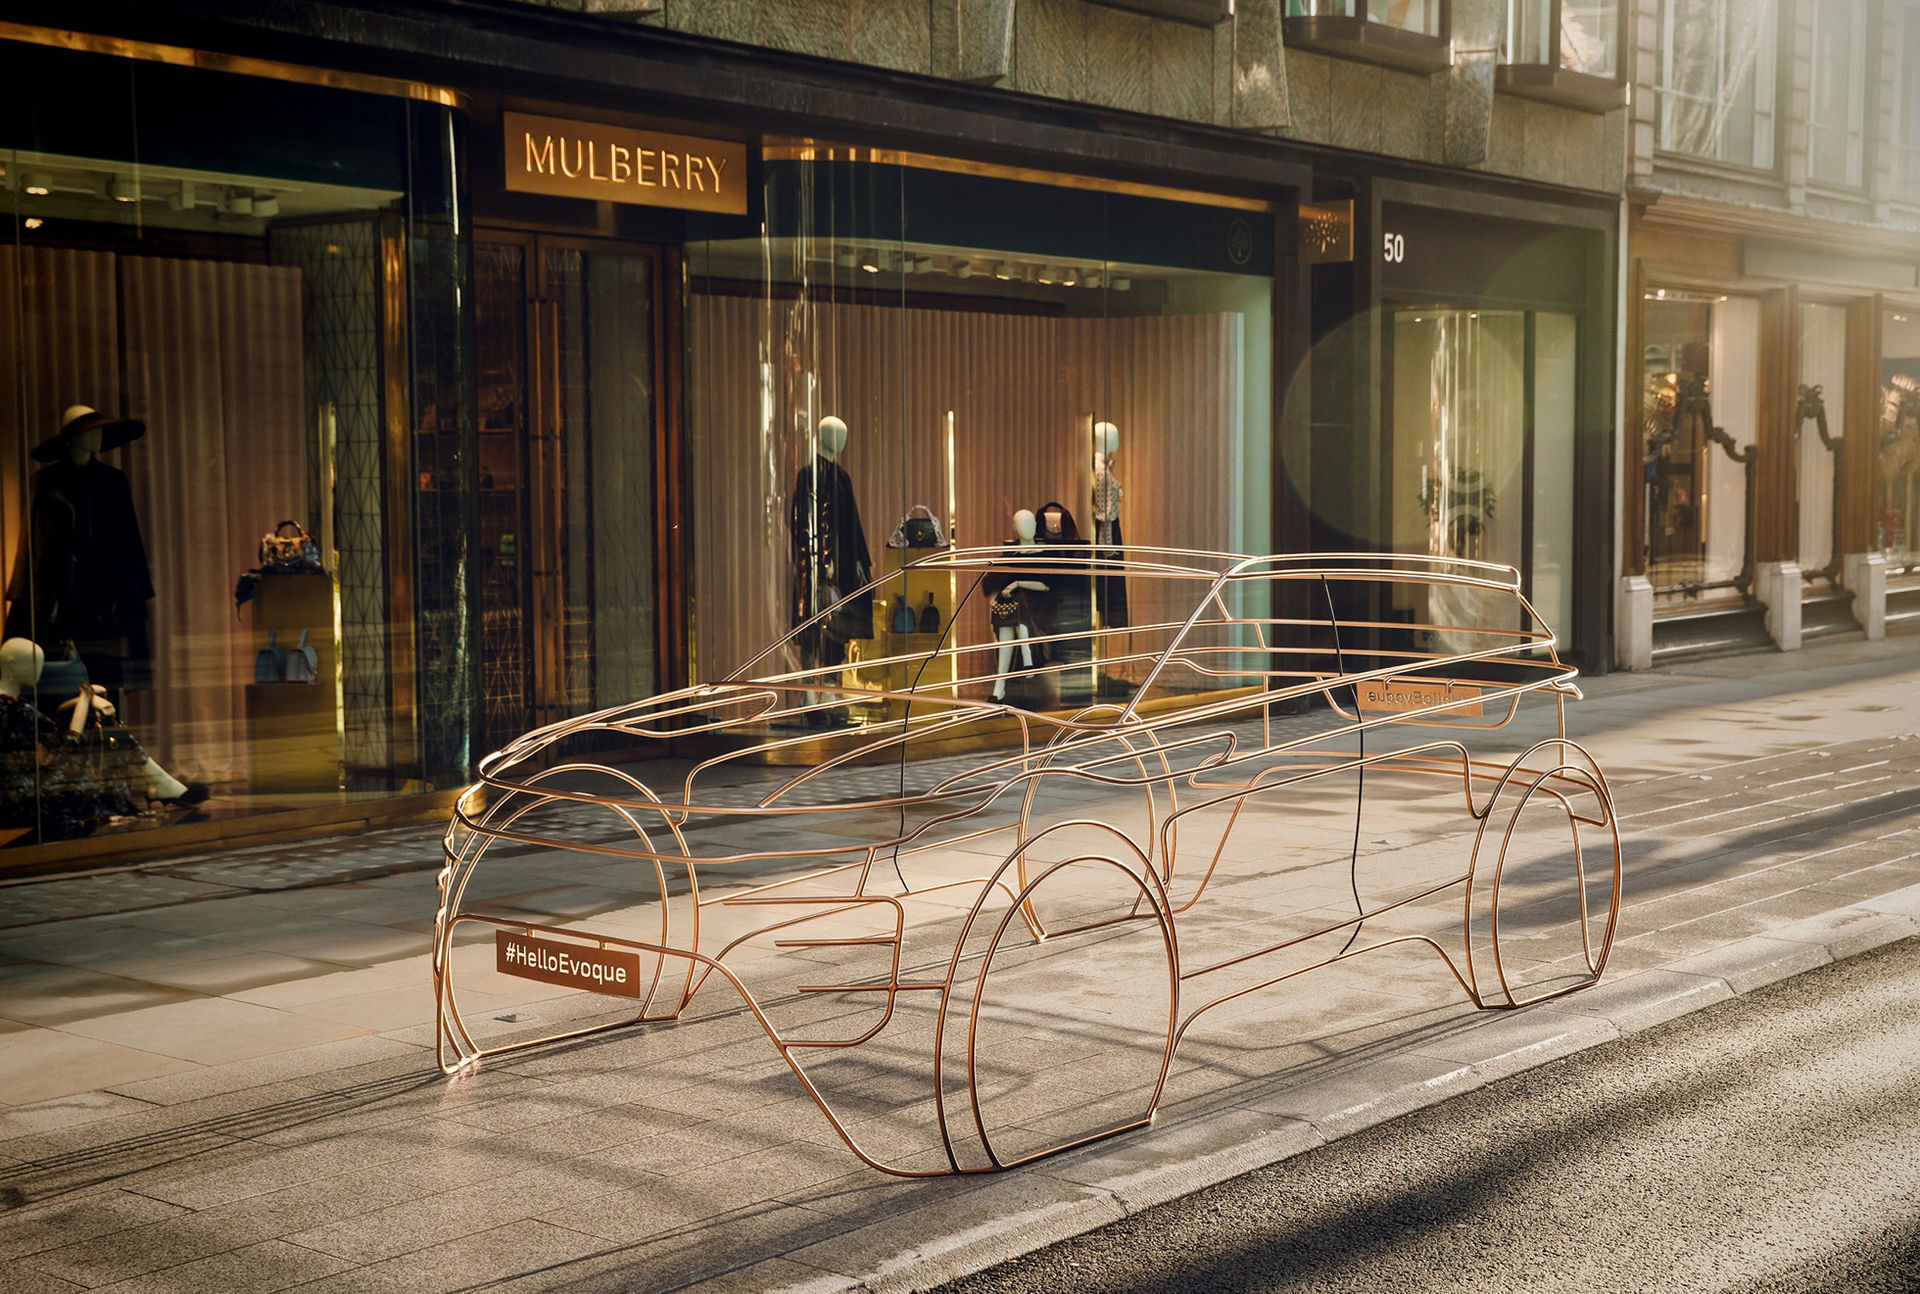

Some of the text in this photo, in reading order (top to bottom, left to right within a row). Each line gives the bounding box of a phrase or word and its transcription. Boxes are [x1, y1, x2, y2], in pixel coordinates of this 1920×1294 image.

[525, 132, 727, 193] MULBERRY
[1384, 232, 1404, 263] 50
[505, 942, 627, 985] #HelloEvoque
